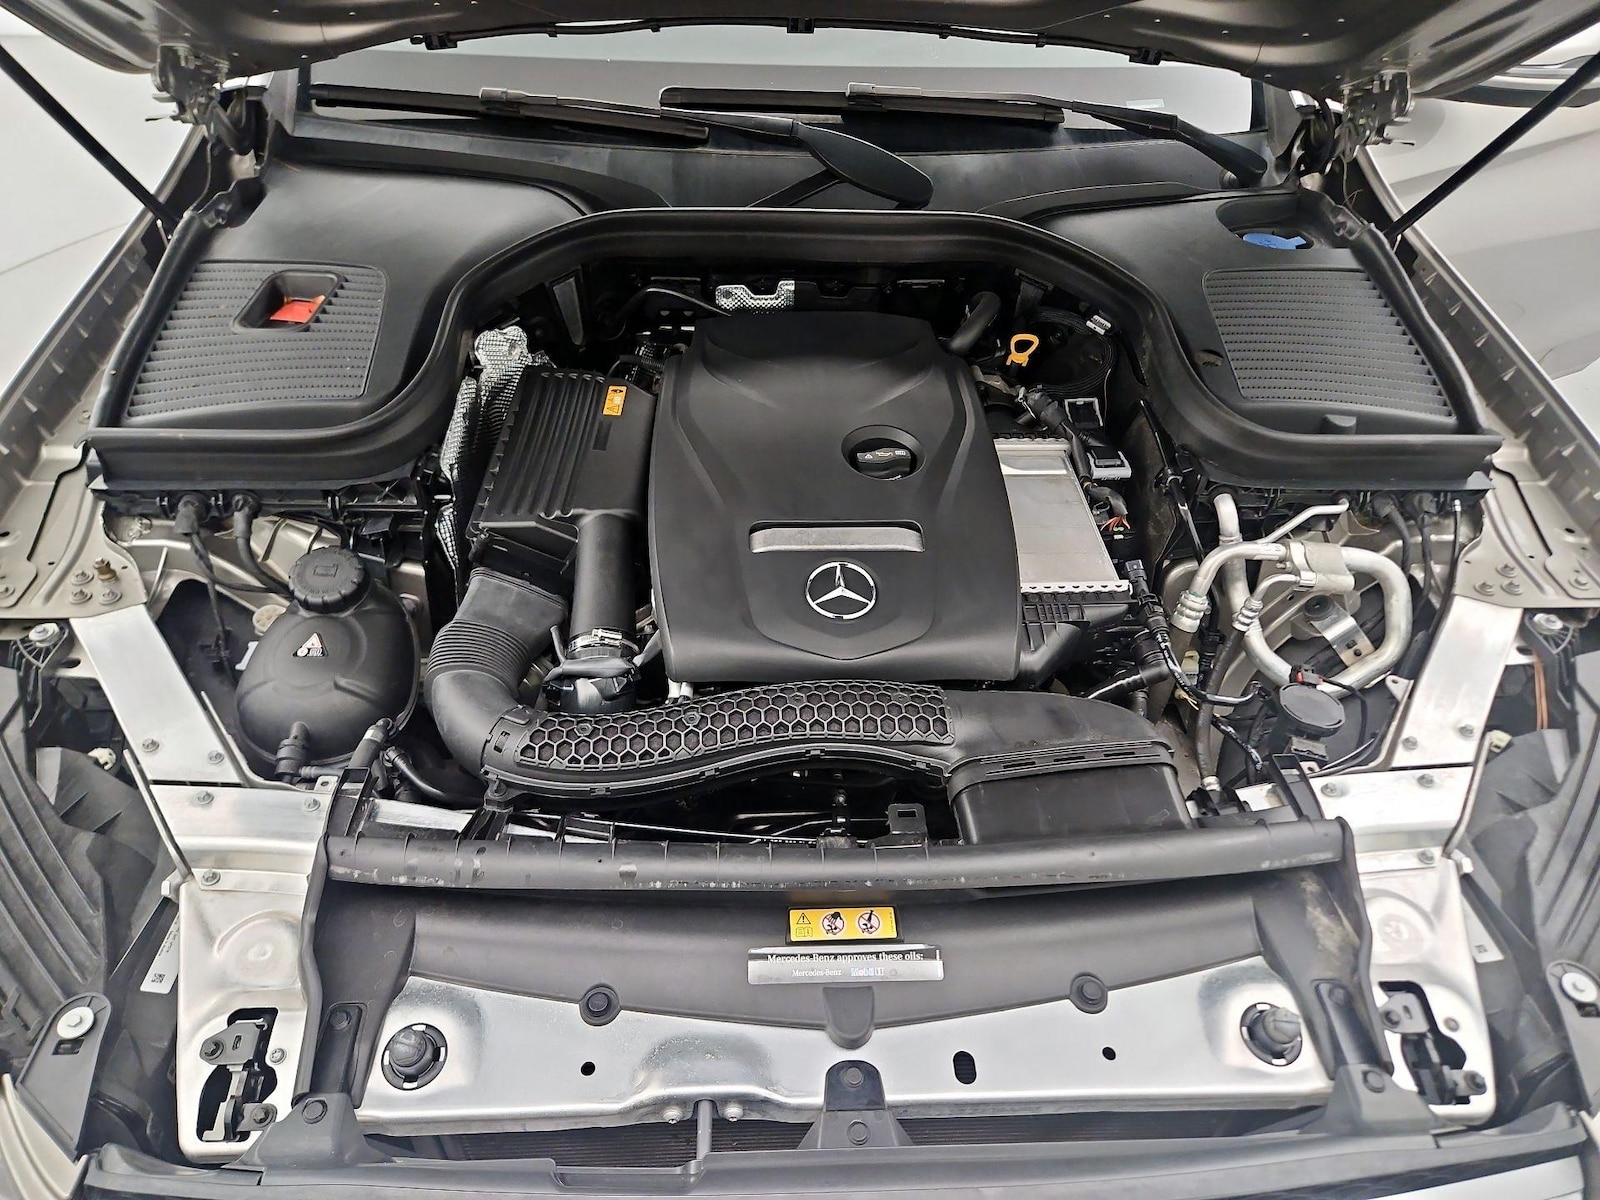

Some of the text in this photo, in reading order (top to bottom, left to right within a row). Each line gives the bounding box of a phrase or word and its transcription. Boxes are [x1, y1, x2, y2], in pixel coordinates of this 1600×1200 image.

[767, 950, 925, 963] Mercedes-Benz approves these oils:
[792, 968, 843, 977] Mercedes-Benz
